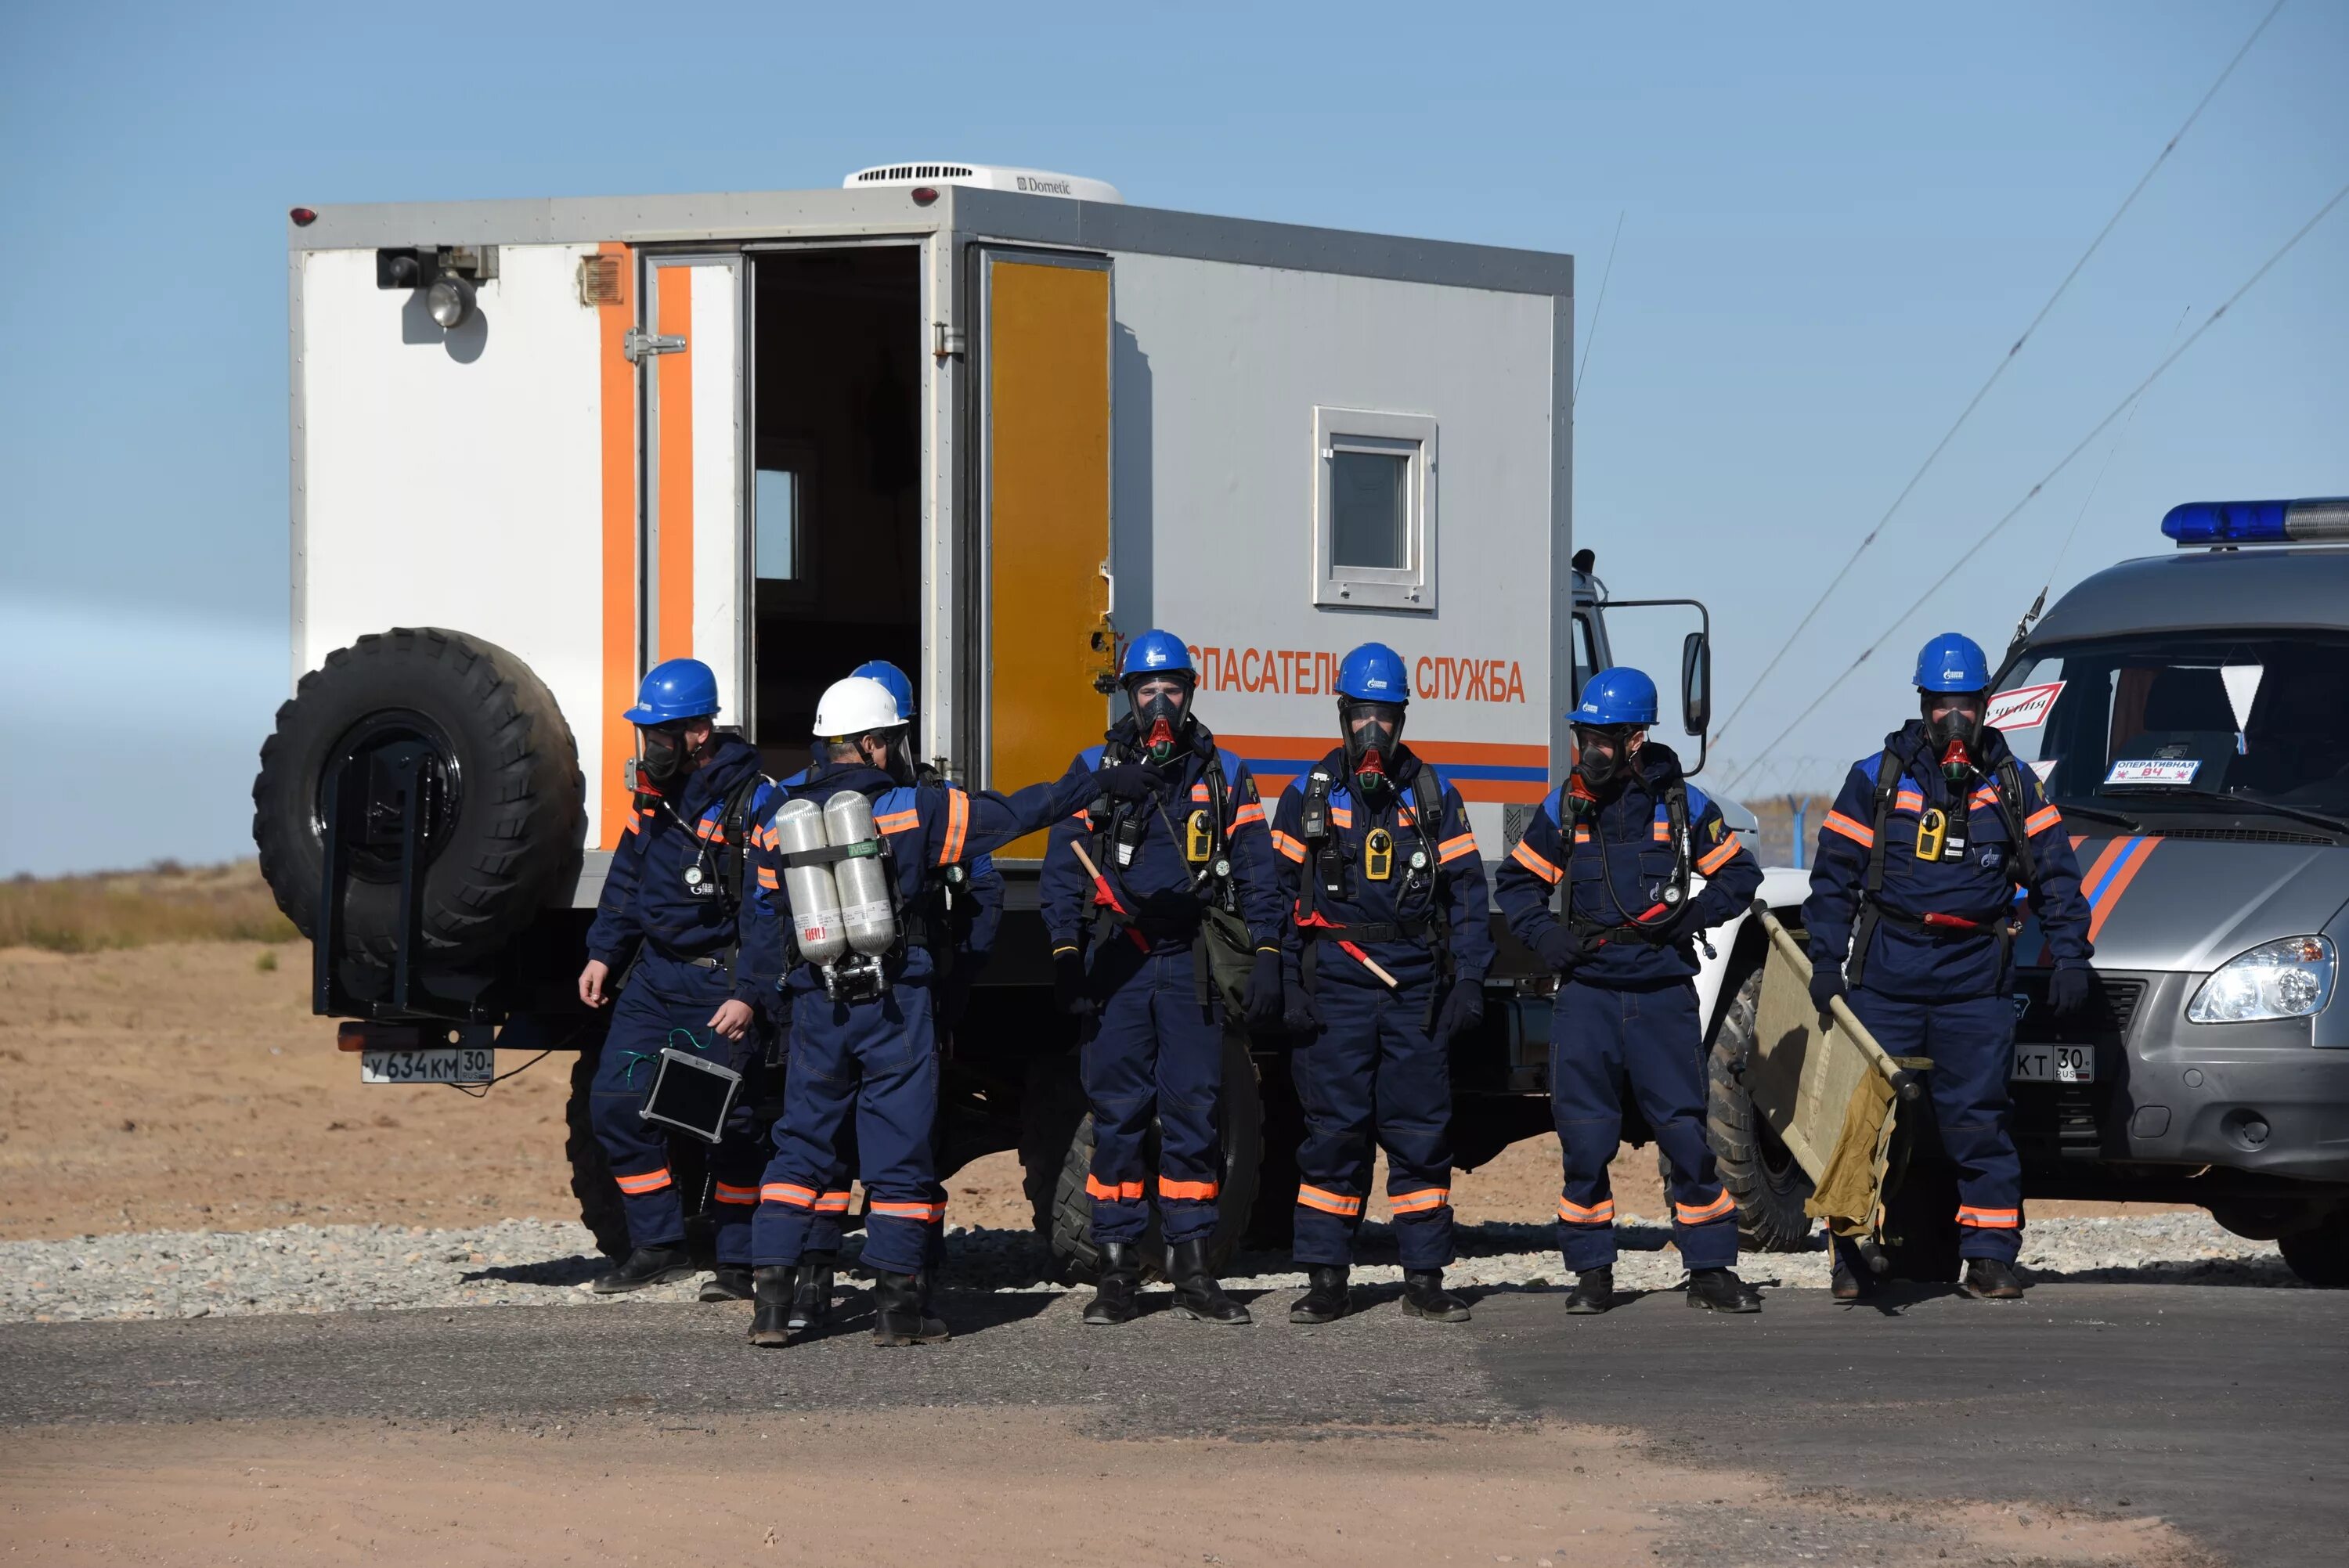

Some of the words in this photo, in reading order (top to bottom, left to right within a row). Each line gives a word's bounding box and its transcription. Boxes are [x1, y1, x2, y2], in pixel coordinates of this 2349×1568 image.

[1029, 177, 1071, 196] Dometic
[1416, 656, 1525, 704] СЛУЖБА
[2141, 767, 2163, 777] ВЧ
[850, 842, 877, 855] MSA
[464, 1051, 485, 1071] 30
[2017, 1054, 2048, 1076] КТ
[2057, 1047, 2084, 1069] 30
[2055, 1070, 2075, 1079] RUS
